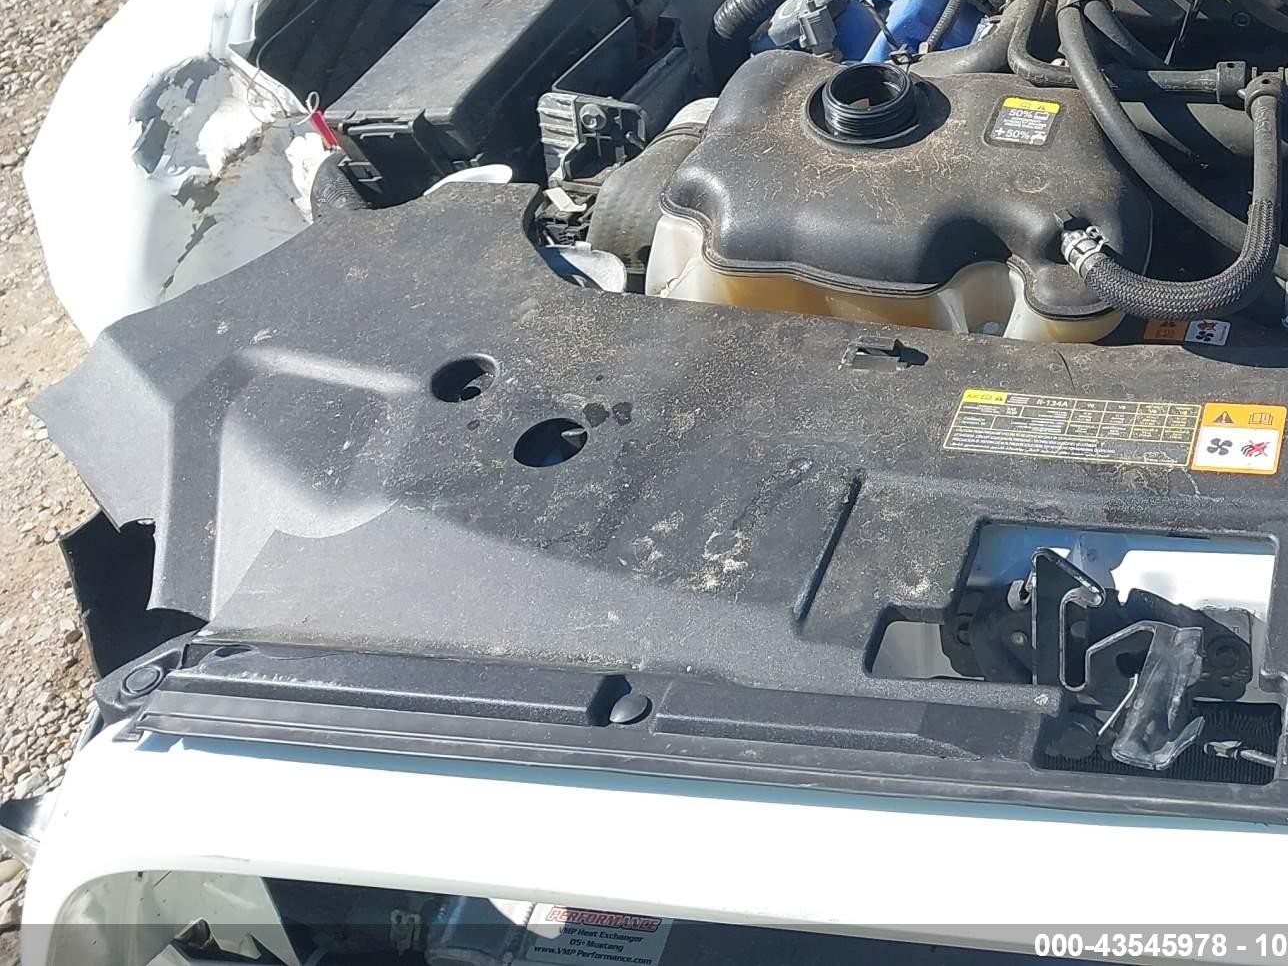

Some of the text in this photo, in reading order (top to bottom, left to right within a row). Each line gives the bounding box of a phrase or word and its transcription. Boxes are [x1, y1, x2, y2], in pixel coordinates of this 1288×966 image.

[548, 908, 659, 931] PERFORMANCE
[578, 928, 598, 938] Heat
[599, 931, 645, 944] Exchanger
[586, 940, 624, 952] Mustang
